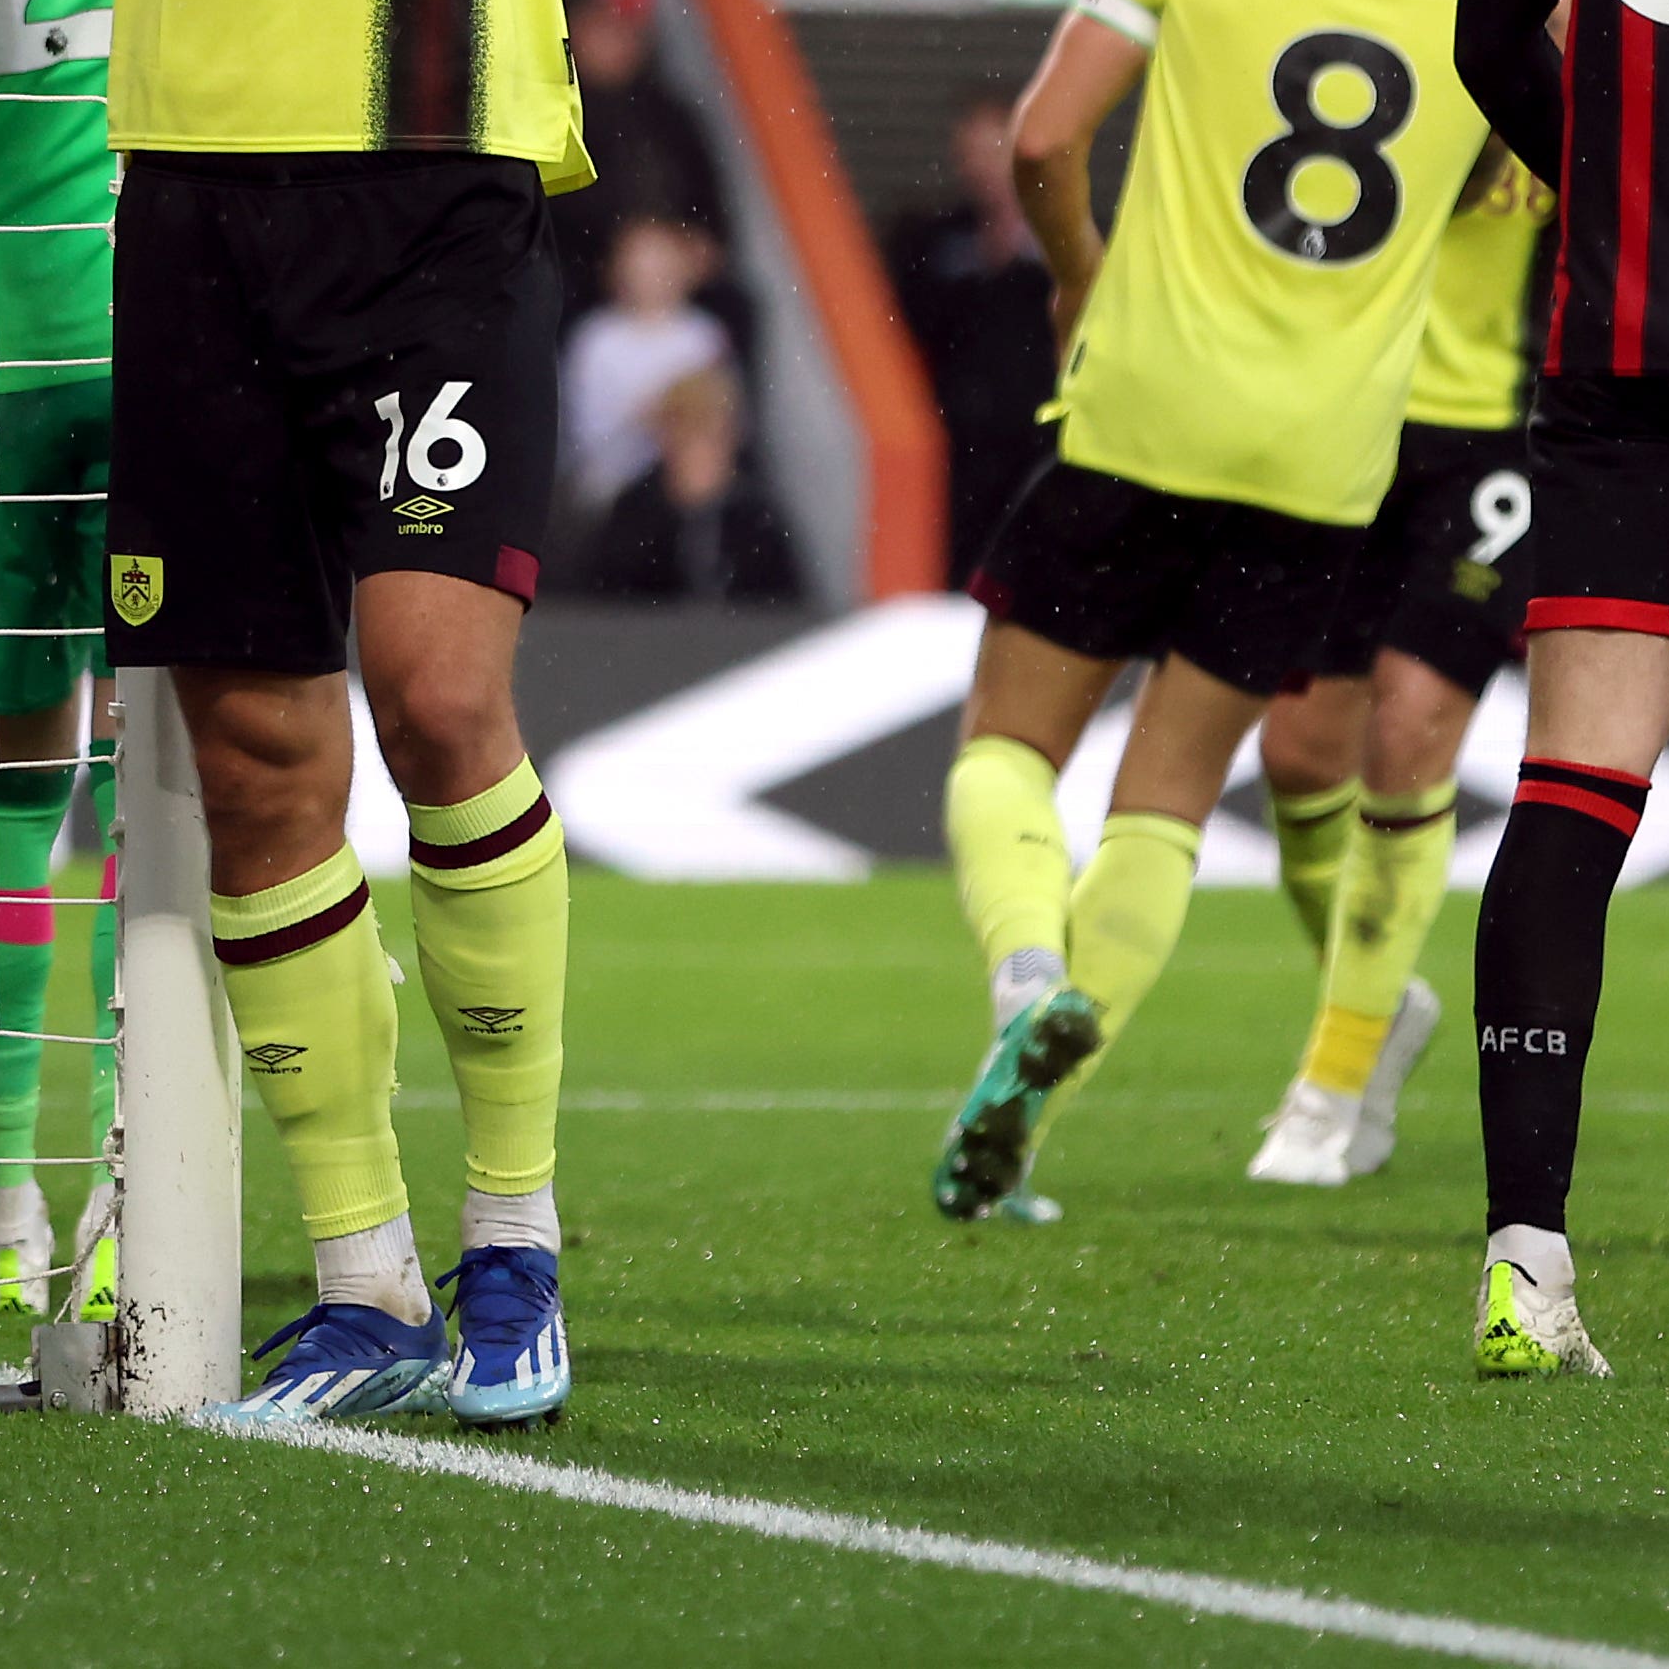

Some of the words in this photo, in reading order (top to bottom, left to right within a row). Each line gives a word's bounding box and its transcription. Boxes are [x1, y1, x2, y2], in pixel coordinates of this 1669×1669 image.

[1242, 30, 1417, 267] 8
[374, 381, 487, 501] 16
[398, 521, 444, 535] umbro
[1480, 1024, 1568, 1056] AFCB
